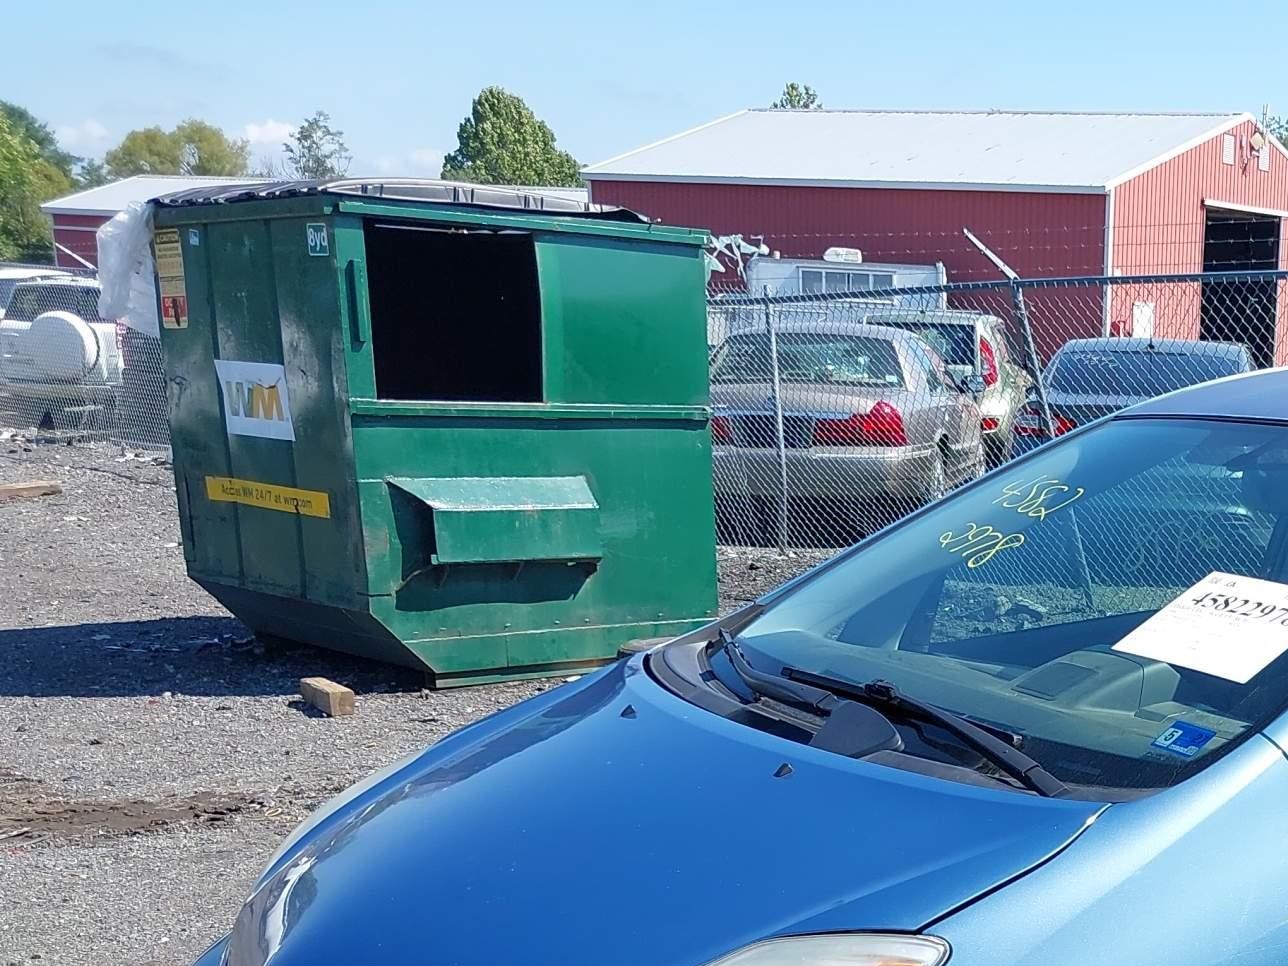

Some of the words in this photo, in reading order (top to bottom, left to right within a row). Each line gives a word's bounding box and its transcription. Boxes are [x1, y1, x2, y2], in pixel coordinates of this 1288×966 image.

[308, 227, 328, 251] 8yd
[226, 380, 286, 422] WM
[255, 488, 272, 501] 24/7
[274, 493, 282, 504] at
[992, 475, 1085, 522] 4582
[940, 523, 1025, 568] 2978
[1164, 730, 1179, 742] 5
